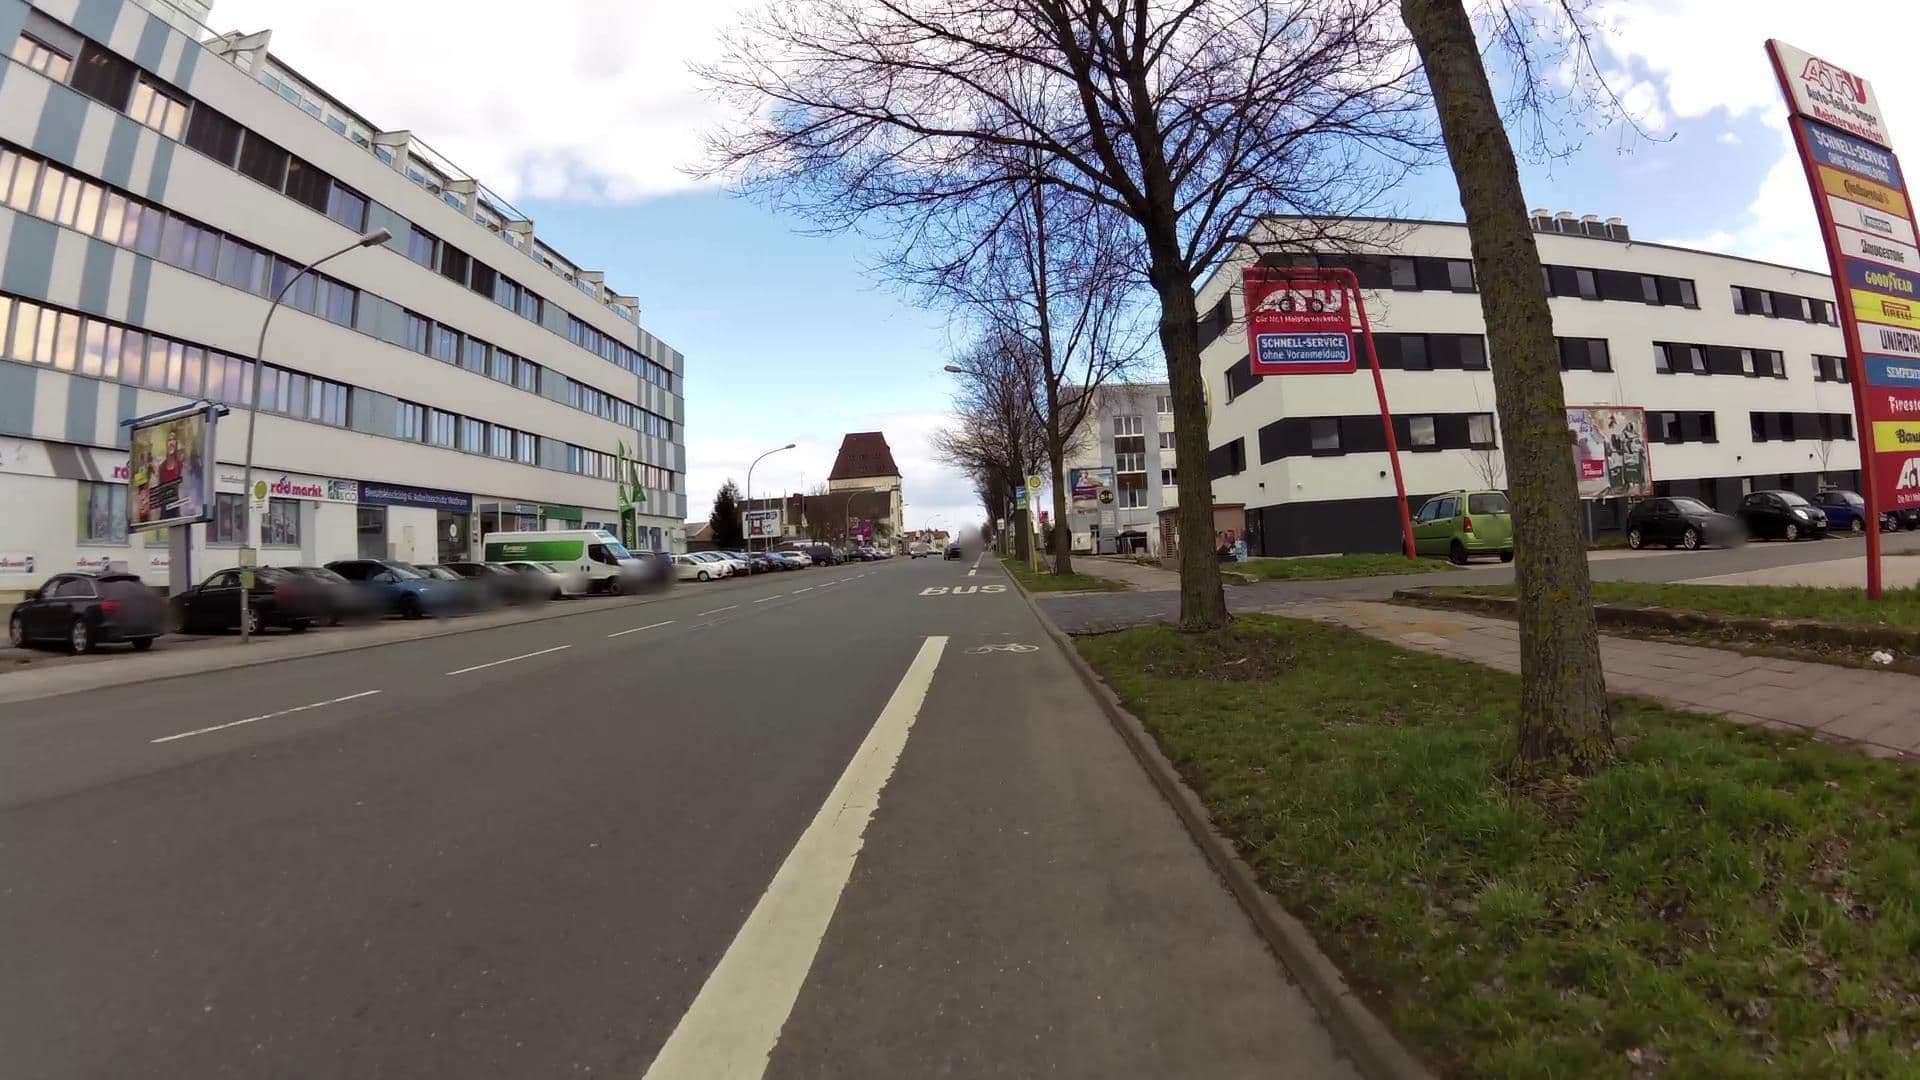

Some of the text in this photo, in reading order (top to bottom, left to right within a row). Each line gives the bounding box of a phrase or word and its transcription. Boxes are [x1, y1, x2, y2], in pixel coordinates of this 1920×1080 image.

[1813, 128, 1890, 169] SCHNELL-SERVICE
[1864, 270, 1913, 294] GOODYEAR
[1880, 300, 1912, 321] PIRELLI
[1261, 338, 1344, 349] SCHNELL-SERVICE
[1262, 349, 1346, 361] ohne Voranmeldung
[918, 584, 1007, 596] BUS
